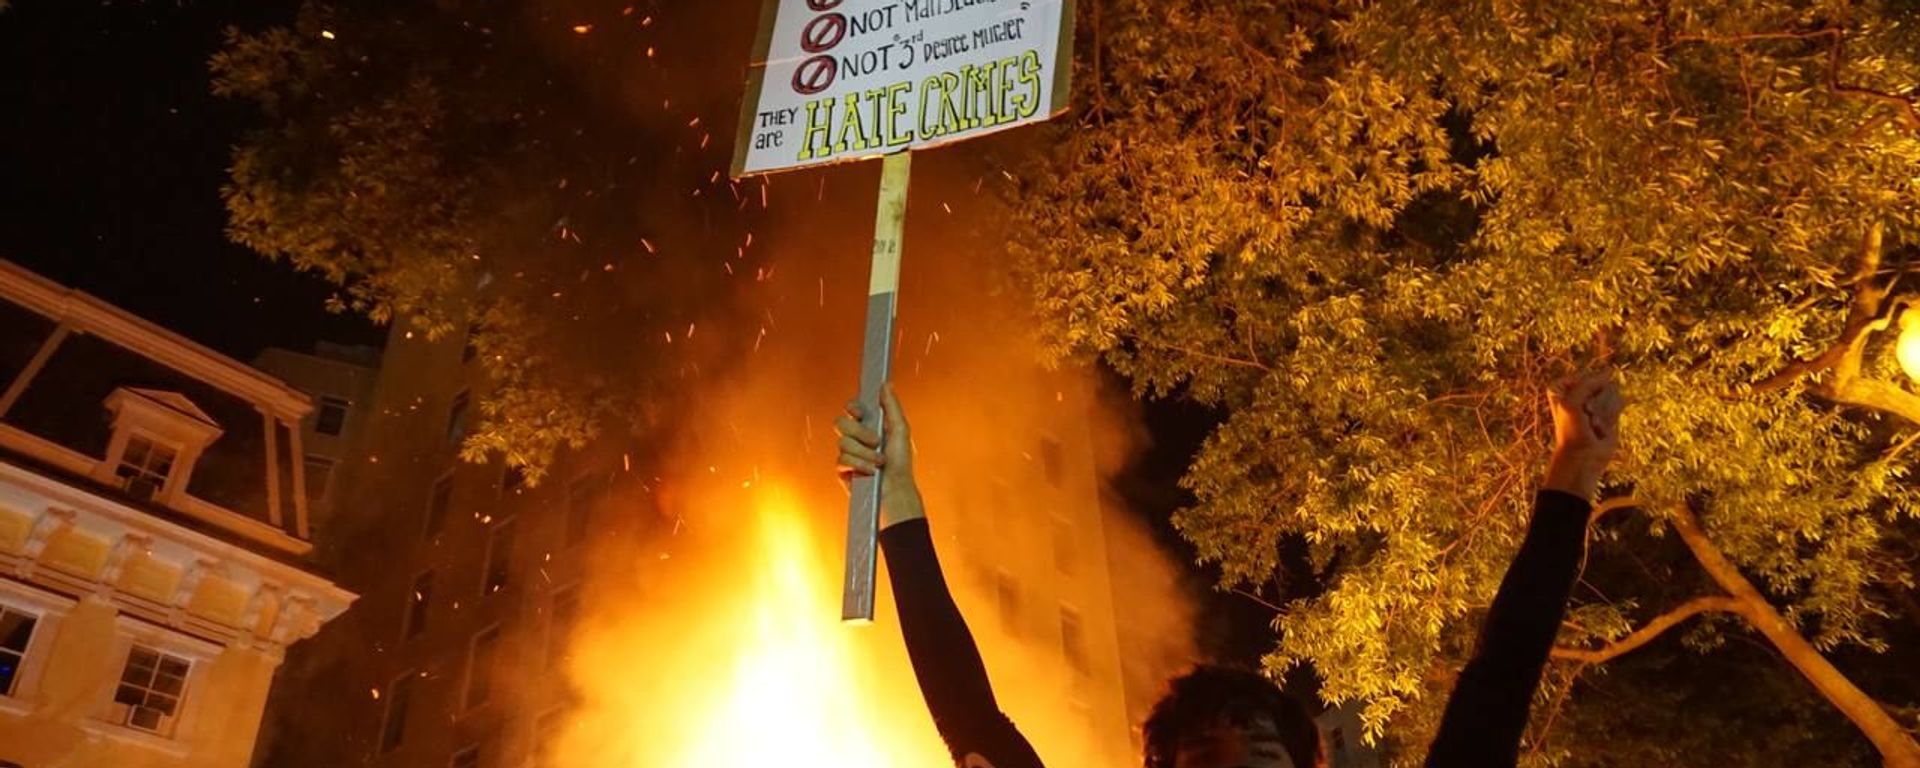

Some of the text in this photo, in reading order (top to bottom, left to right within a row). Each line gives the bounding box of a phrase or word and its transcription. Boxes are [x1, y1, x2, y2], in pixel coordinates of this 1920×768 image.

[850, 4, 898, 38] NOT
[841, 43, 895, 80] NOT
[759, 106, 799, 128] THEY
[797, 49, 1042, 160] HATE CRIMES
[755, 130, 783, 150] are
